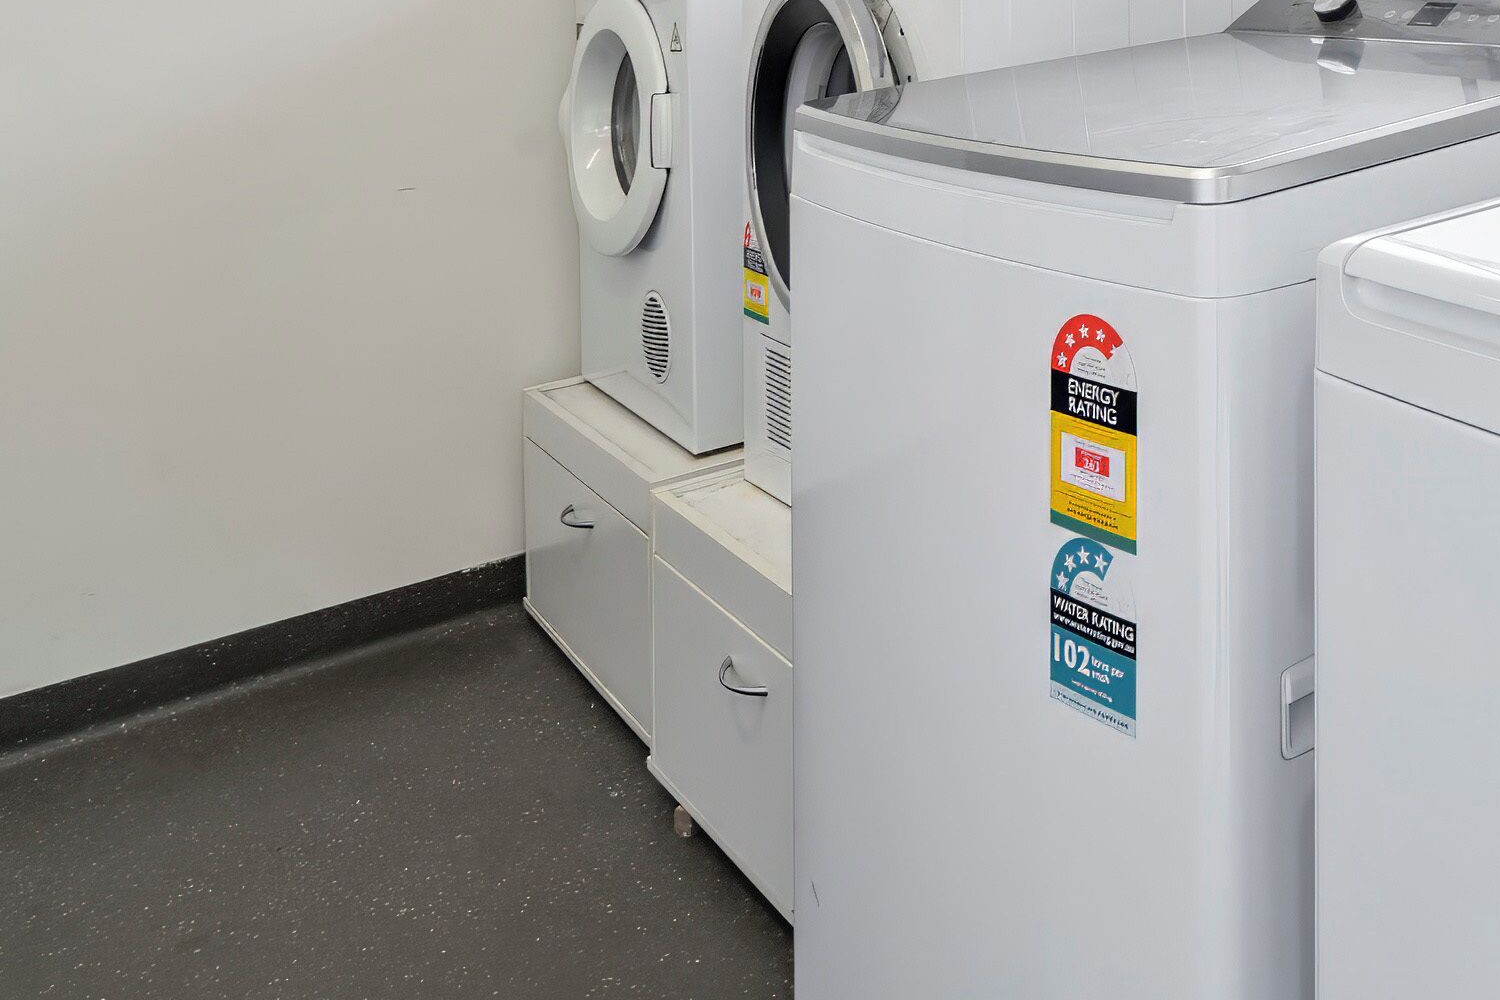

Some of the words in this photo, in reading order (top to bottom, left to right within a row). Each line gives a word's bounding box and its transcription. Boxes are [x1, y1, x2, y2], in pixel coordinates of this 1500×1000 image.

[1068, 377, 1120, 407] ENERGY
[1069, 396, 1117, 425] RATING
[1053, 594, 1089, 623] WATER
[1092, 611, 1134, 642] RATING
[1054, 632, 1090, 677] 102
